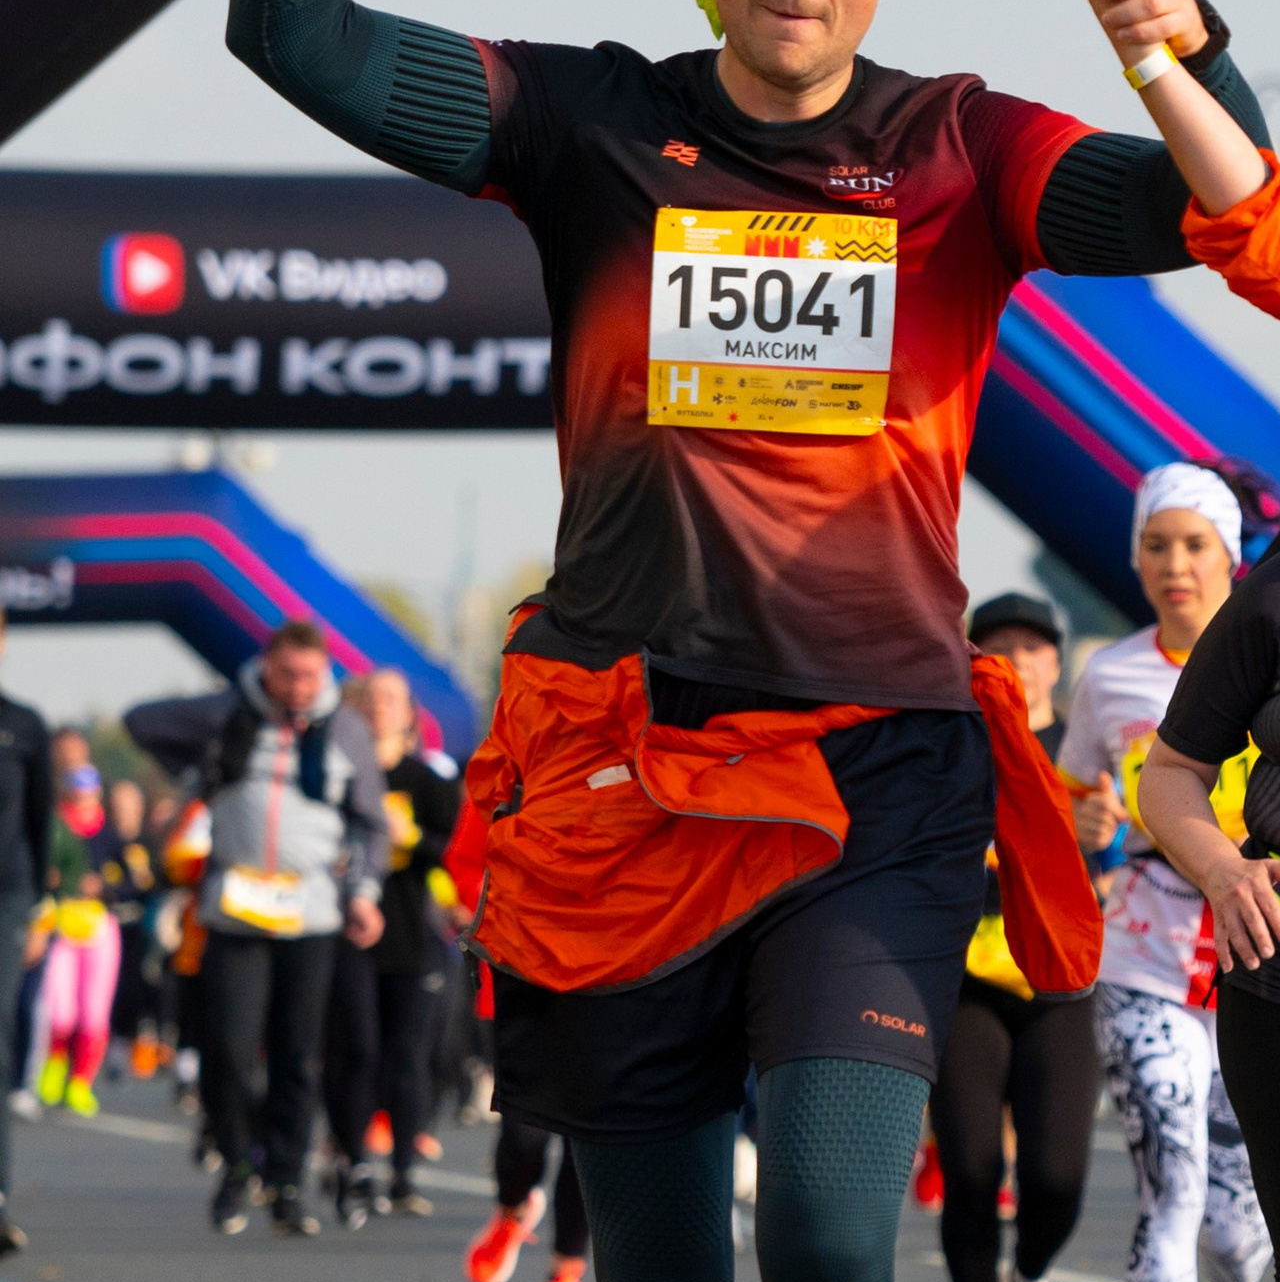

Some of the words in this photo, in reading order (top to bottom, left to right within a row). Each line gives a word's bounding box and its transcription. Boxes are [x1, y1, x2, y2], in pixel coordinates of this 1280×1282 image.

[829, 166, 869, 177] SOLAR
[863, 198, 896, 210] CLUB
[832, 218, 852, 235] 10
[197, 250, 276, 301] VK
[280, 251, 448, 307] Видео
[668, 265, 876, 338] 15041
[0, 318, 261, 404] ФОН
[725, 339, 817, 361] МАКСИМ
[676, 409, 714, 418] ФУТБОЛКА
[881, 1015, 926, 1037] SOLAR
